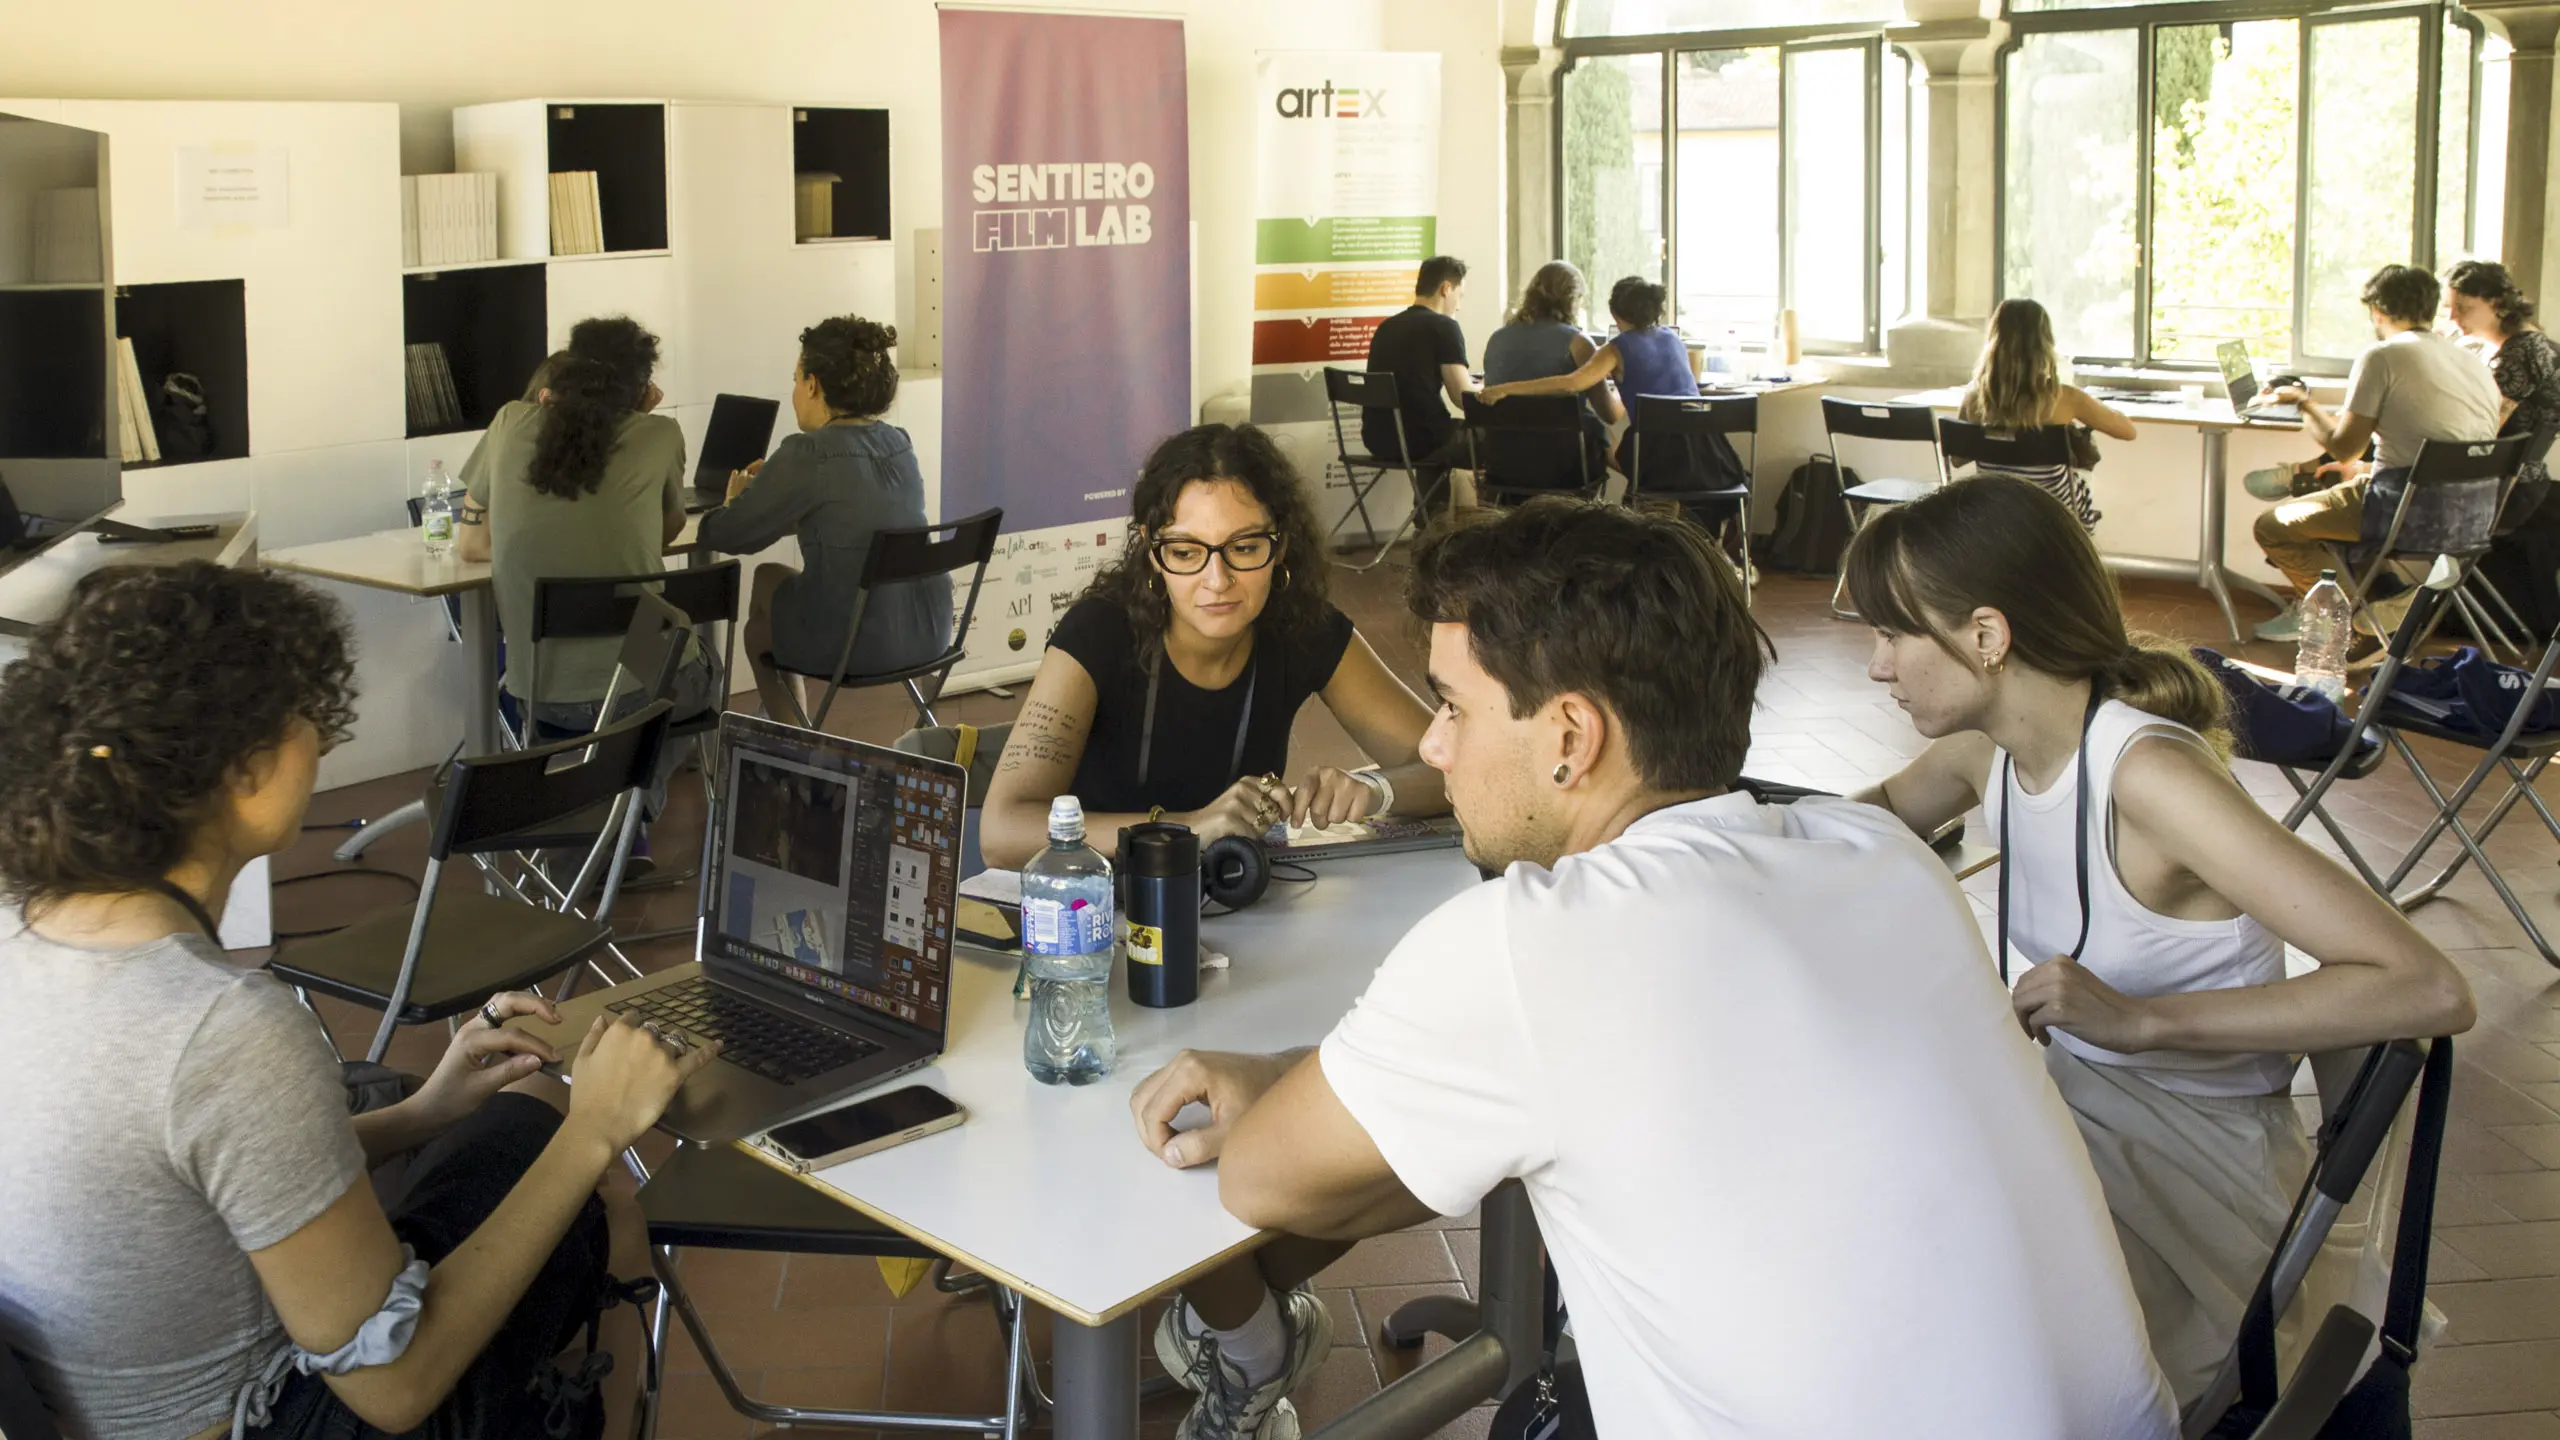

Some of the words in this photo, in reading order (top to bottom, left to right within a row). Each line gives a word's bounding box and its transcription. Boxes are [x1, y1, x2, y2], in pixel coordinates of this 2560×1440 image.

[972, 161, 1155, 203] SENTIERO
[973, 207, 1069, 252] FILM
[1074, 205, 1152, 246] LAB
[1305, 316, 1313, 326] 3
[1084, 489, 1117, 501] POWERED
[1092, 911, 1114, 928] RIV
